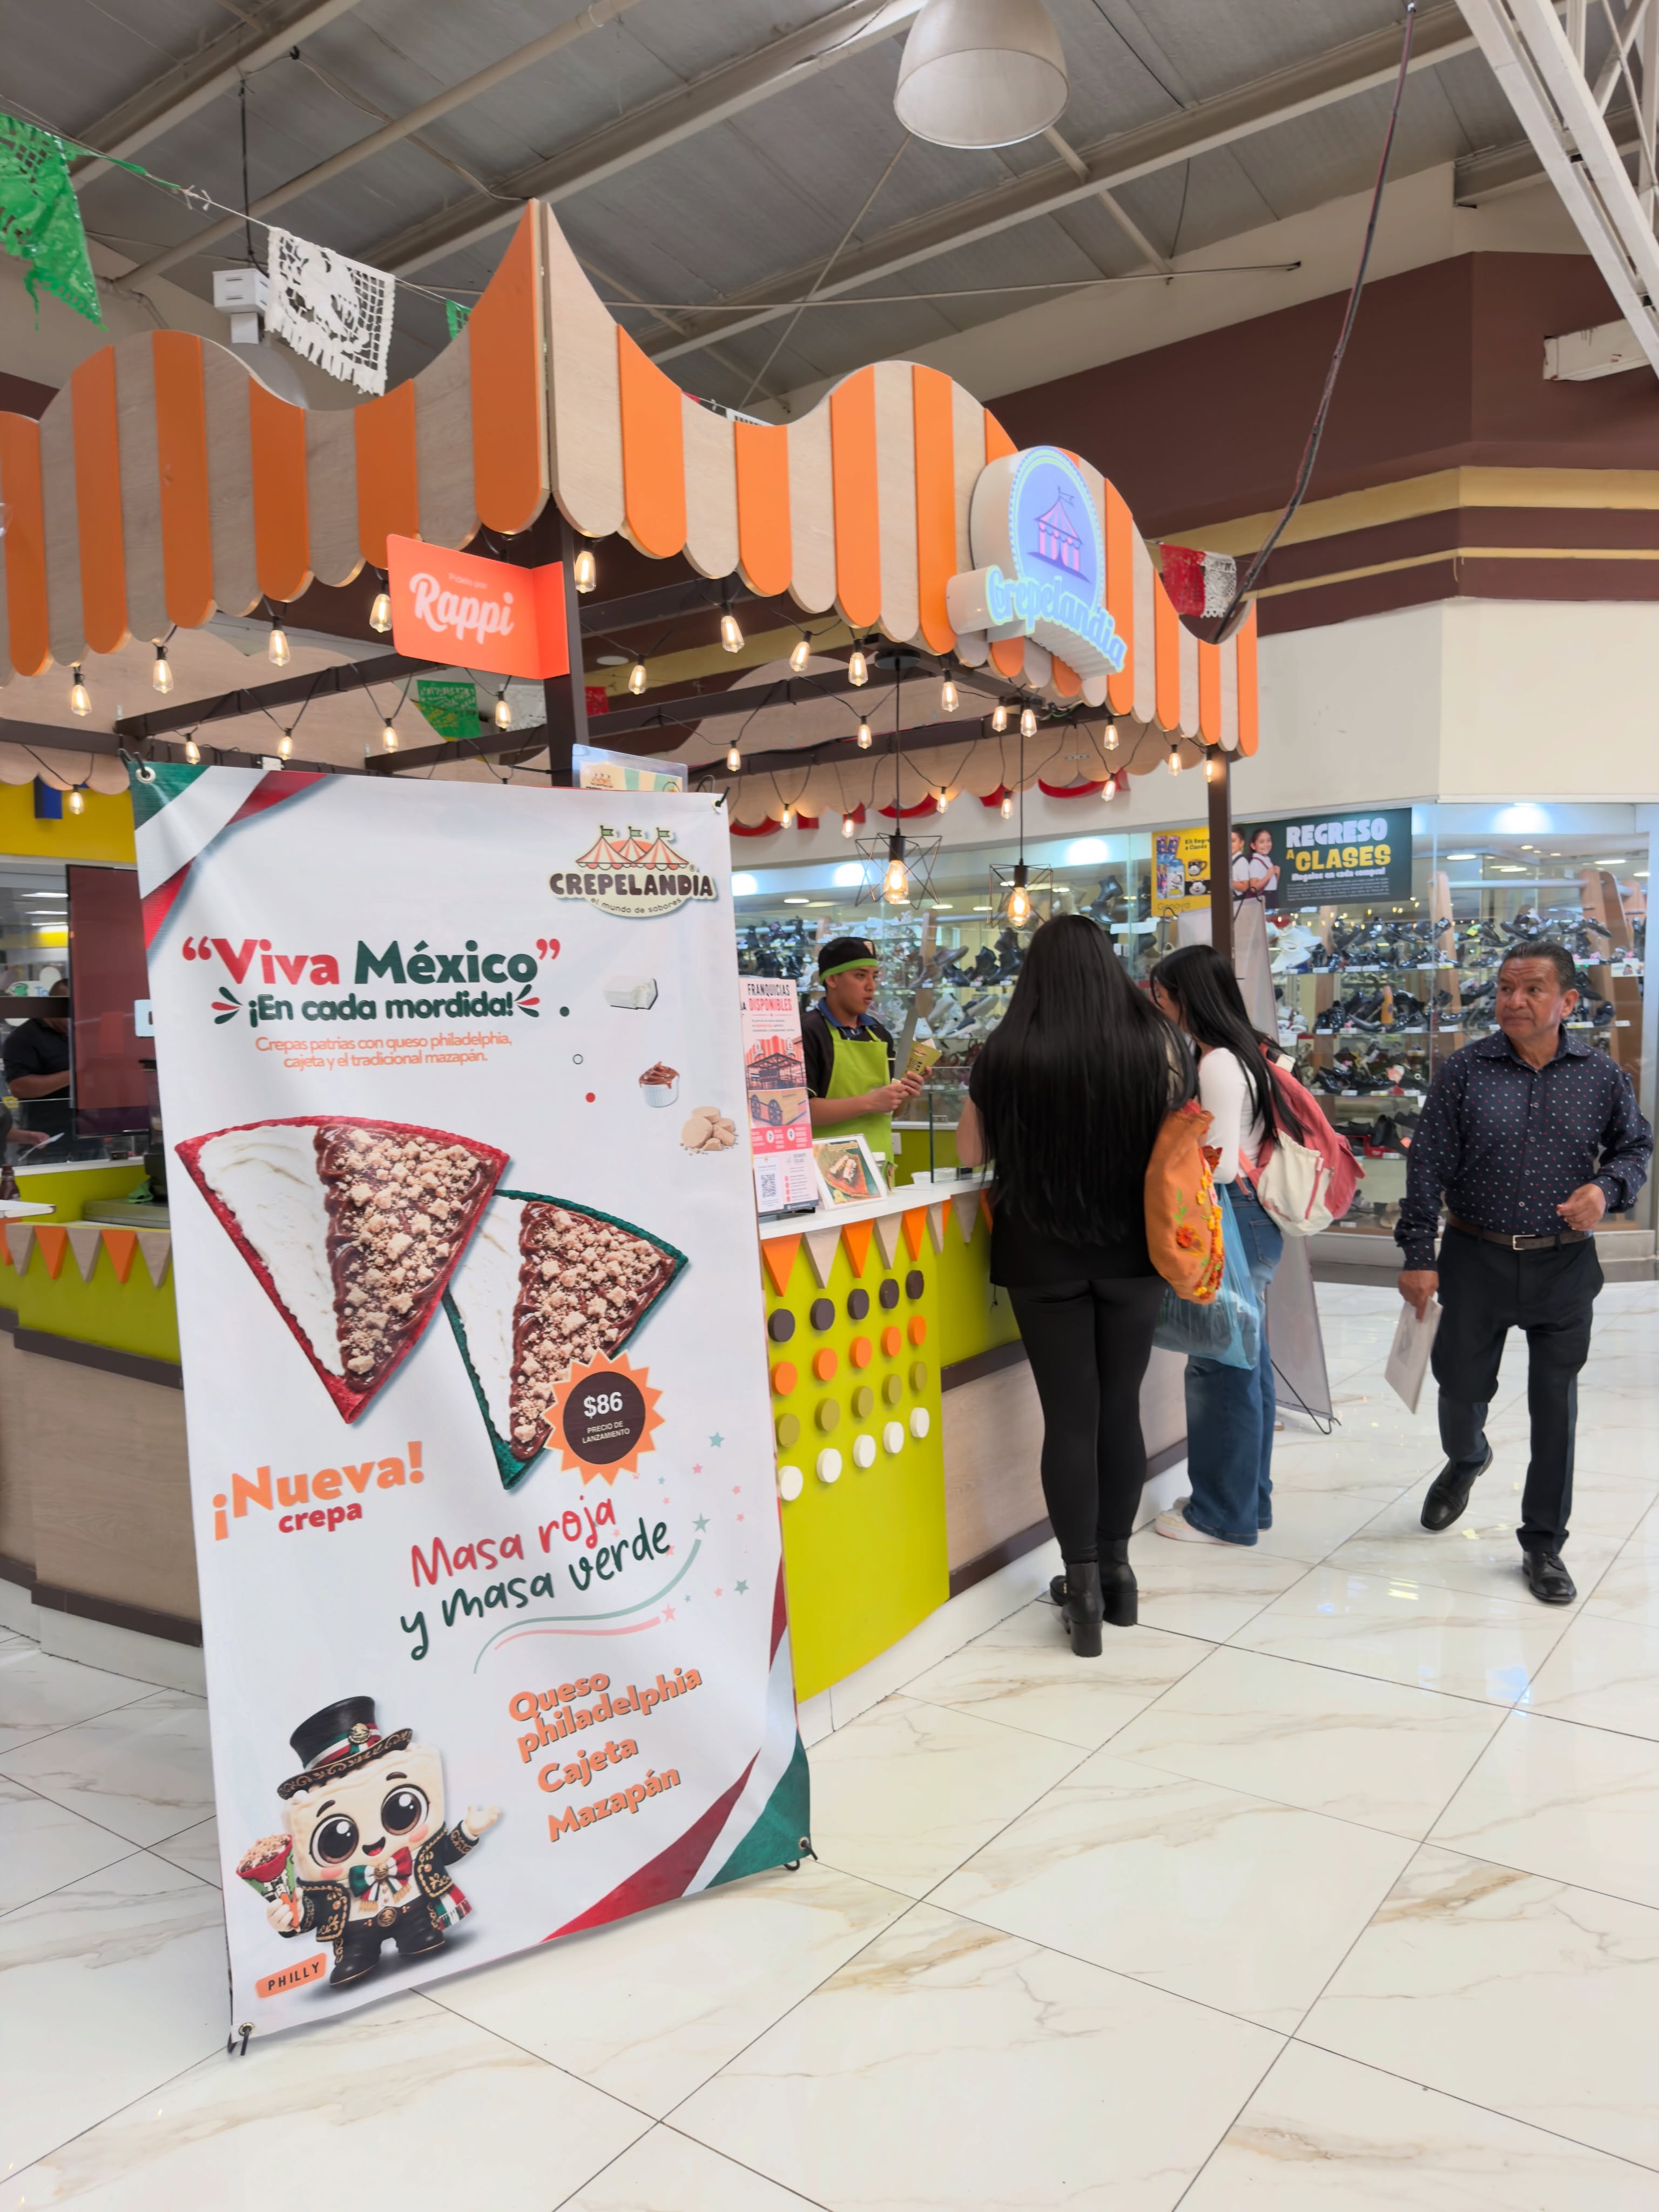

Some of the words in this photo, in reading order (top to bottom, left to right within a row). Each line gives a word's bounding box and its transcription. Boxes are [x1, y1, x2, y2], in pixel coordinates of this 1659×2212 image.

[409, 572, 515, 644] Rappi
[986, 565, 1128, 673] Crepelandia
[1286, 818, 1388, 848] REGRESO
[1286, 849, 1294, 859] A
[1295, 844, 1391, 872] CLASES
[550, 873, 713, 896] CREPELANDIA
[602, 902, 631, 913] mundo
[649, 898, 682, 913] sabores
[747, 983, 790, 996] FRANQUICIAS
[749, 998, 792, 1011] DISPONIBLES
[248, 994, 294, 1028] ¡En
[301, 993, 377, 1021] cada
[386, 990, 514, 1020] mordida!
[255, 1036, 308, 1054] Crepas
[311, 1037, 355, 1052] patrias
[358, 1039, 383, 1049] con
[386, 1037, 428, 1049] queso
[430, 1031, 512, 1049] philadelphia,
[284, 1054, 324, 1071] cajeta
[326, 1058, 334, 1070] y
[337, 1053, 348, 1067] el
[350, 1050, 422, 1066] tradicional
[424, 1048, 488, 1066] mazapán.
[583, 1392, 623, 1419] $86
[582, 1428, 630, 1444] LANZAMIENTO
[587, 1422, 613, 1434] PRECIO
[212, 1440, 426, 1541] ¡Nueva!
[278, 1500, 363, 1534] crepa
[411, 1533, 523, 1587] Masa
[538, 1494, 617, 1547] roja
[400, 1611, 429, 1661] y
[442, 1573, 555, 1627] masa
[569, 1521, 671, 1591] verde
[509, 1673, 610, 1722] Queso
[517, 1667, 702, 1763] philadelphia
[537, 1738, 638, 1792] Cajeta
[547, 1769, 681, 1843] Mazapán
[268, 1962, 320, 1991] PHILLY
